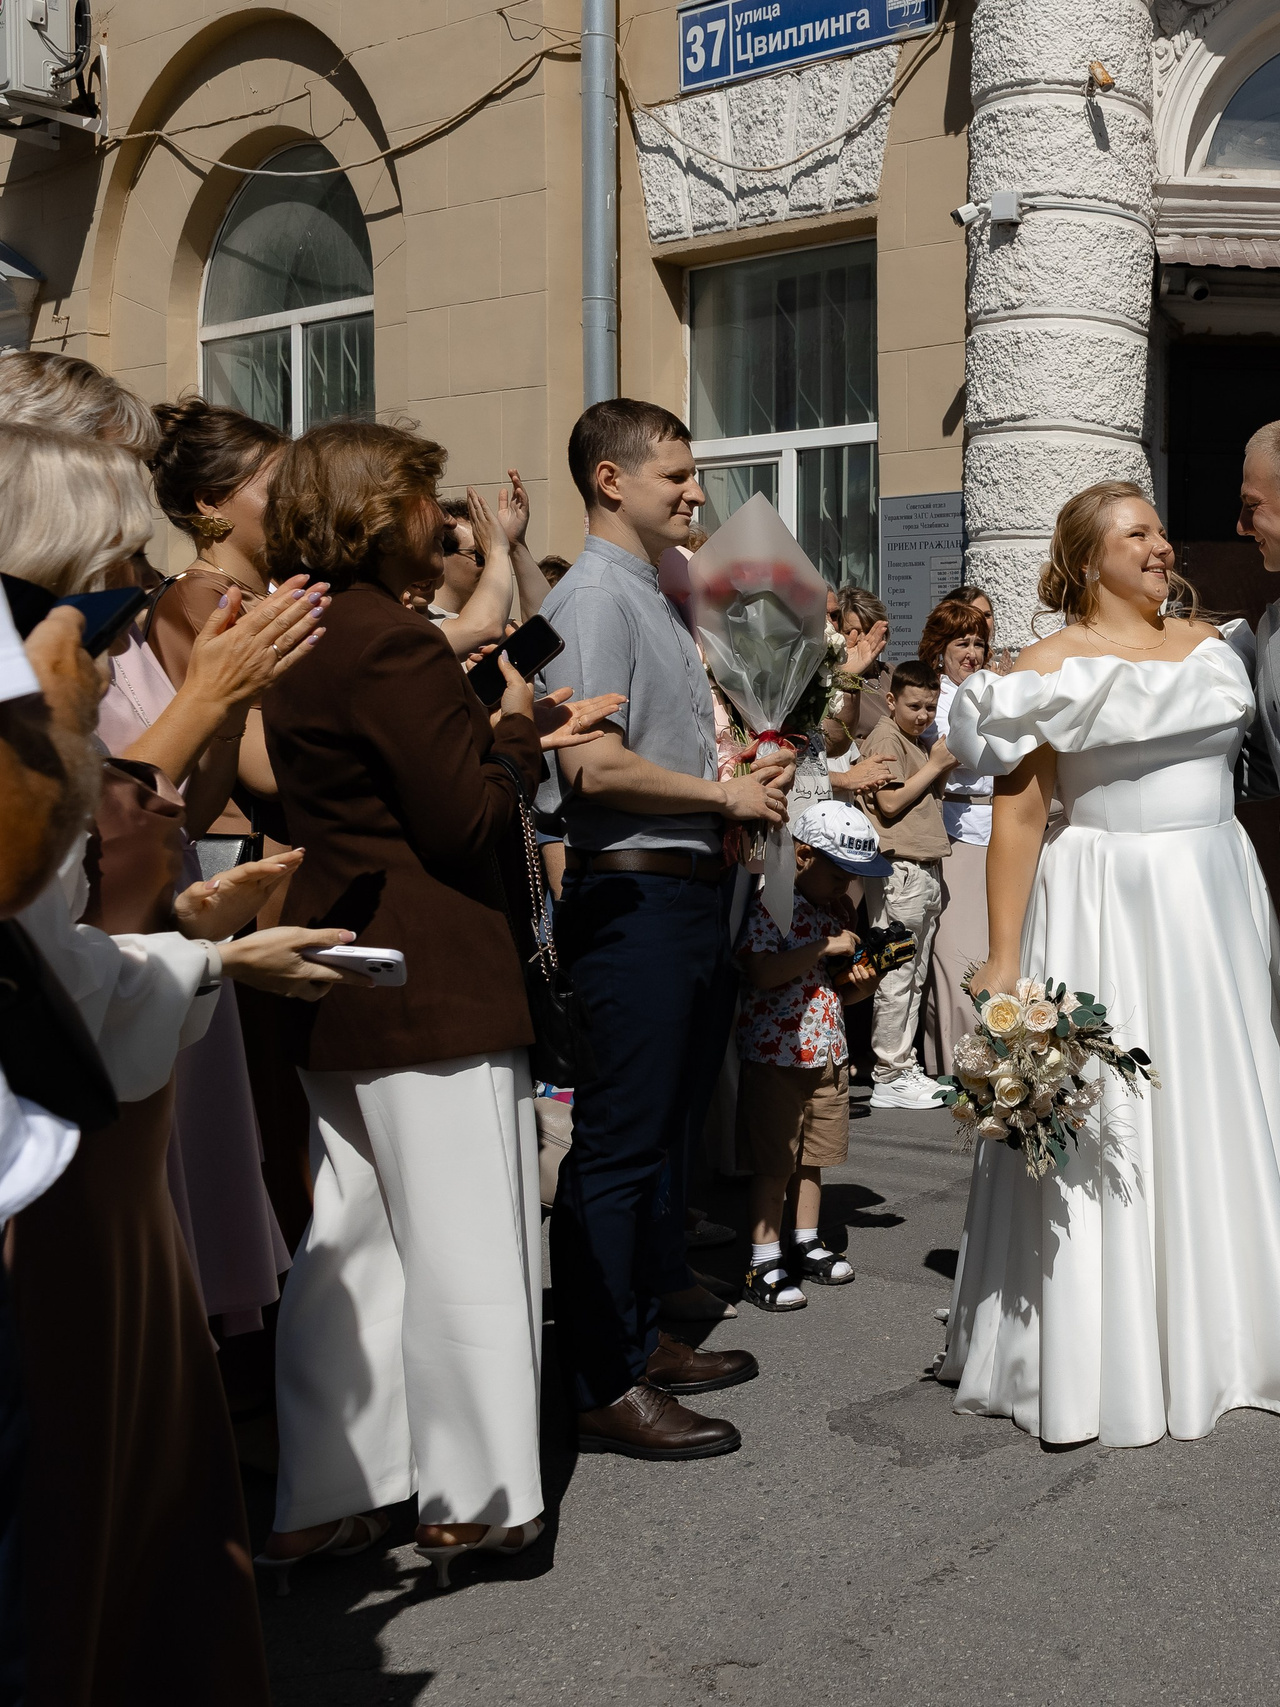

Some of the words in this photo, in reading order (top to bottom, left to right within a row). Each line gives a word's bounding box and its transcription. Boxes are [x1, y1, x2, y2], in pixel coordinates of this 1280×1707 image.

[735, 2, 781, 31] улица
[736, 8, 870, 64] Цвиллинга
[686, 19, 726, 73] 37
[929, 511, 962, 519] Администра
[920, 521, 950, 529] Челябинска
[887, 542, 917, 551] ПРИЕМ
[919, 540, 962, 550] ГРАЖДАН
[887, 560, 926, 568] Понедельник
[887, 574, 912, 582] Вторник
[887, 586, 906, 595] Среда
[887, 600, 911, 608] Четверг
